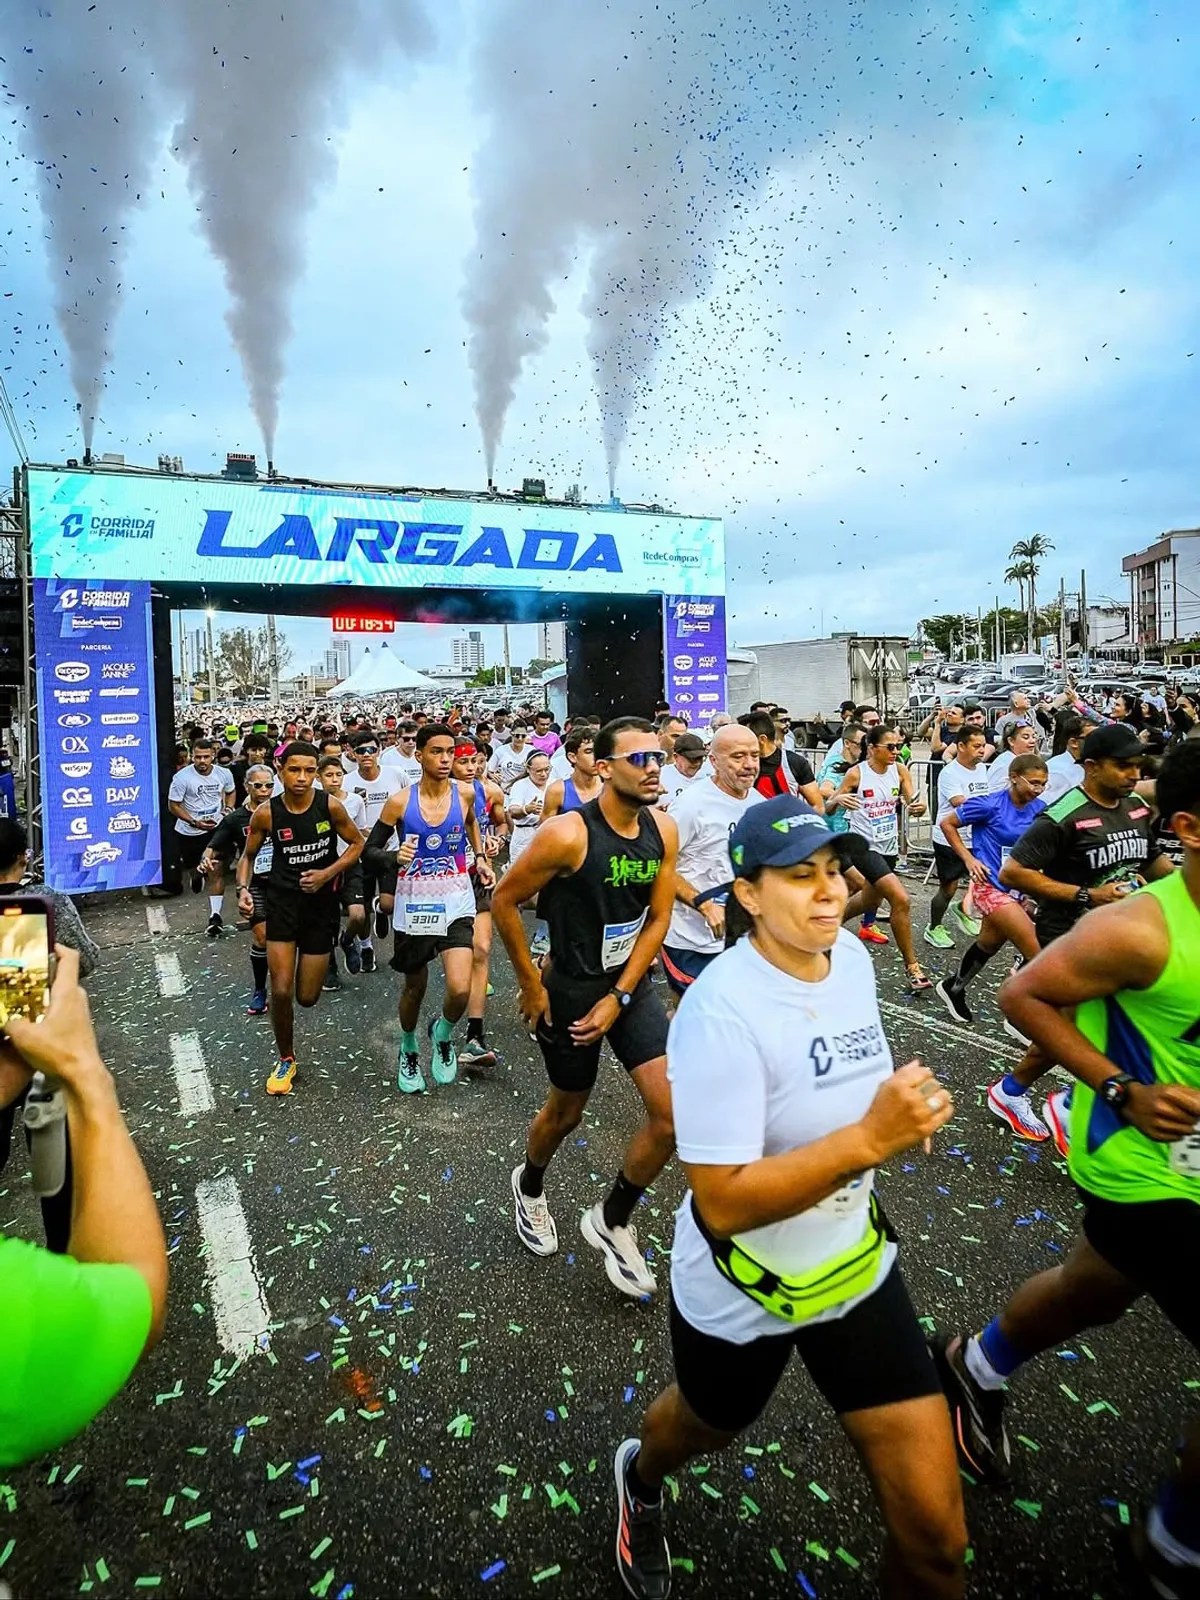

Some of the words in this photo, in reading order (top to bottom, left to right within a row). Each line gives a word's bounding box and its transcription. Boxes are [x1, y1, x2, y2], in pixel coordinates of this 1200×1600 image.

[91, 516, 155, 530] CORRIDA
[196, 510, 624, 573] LARGADA
[643, 551, 699, 564] RedeCompras
[82, 591, 130, 603] CORRIDA
[101, 663, 136, 672] JACQUES
[101, 671, 130, 679] JANINE
[64, 765, 88, 773] NISSIN
[106, 786, 140, 804] BALY
[1106, 828, 1141, 841] EQUIPE
[283, 837, 331, 854] PELOTÃO
[411, 915, 440, 925] 3310
